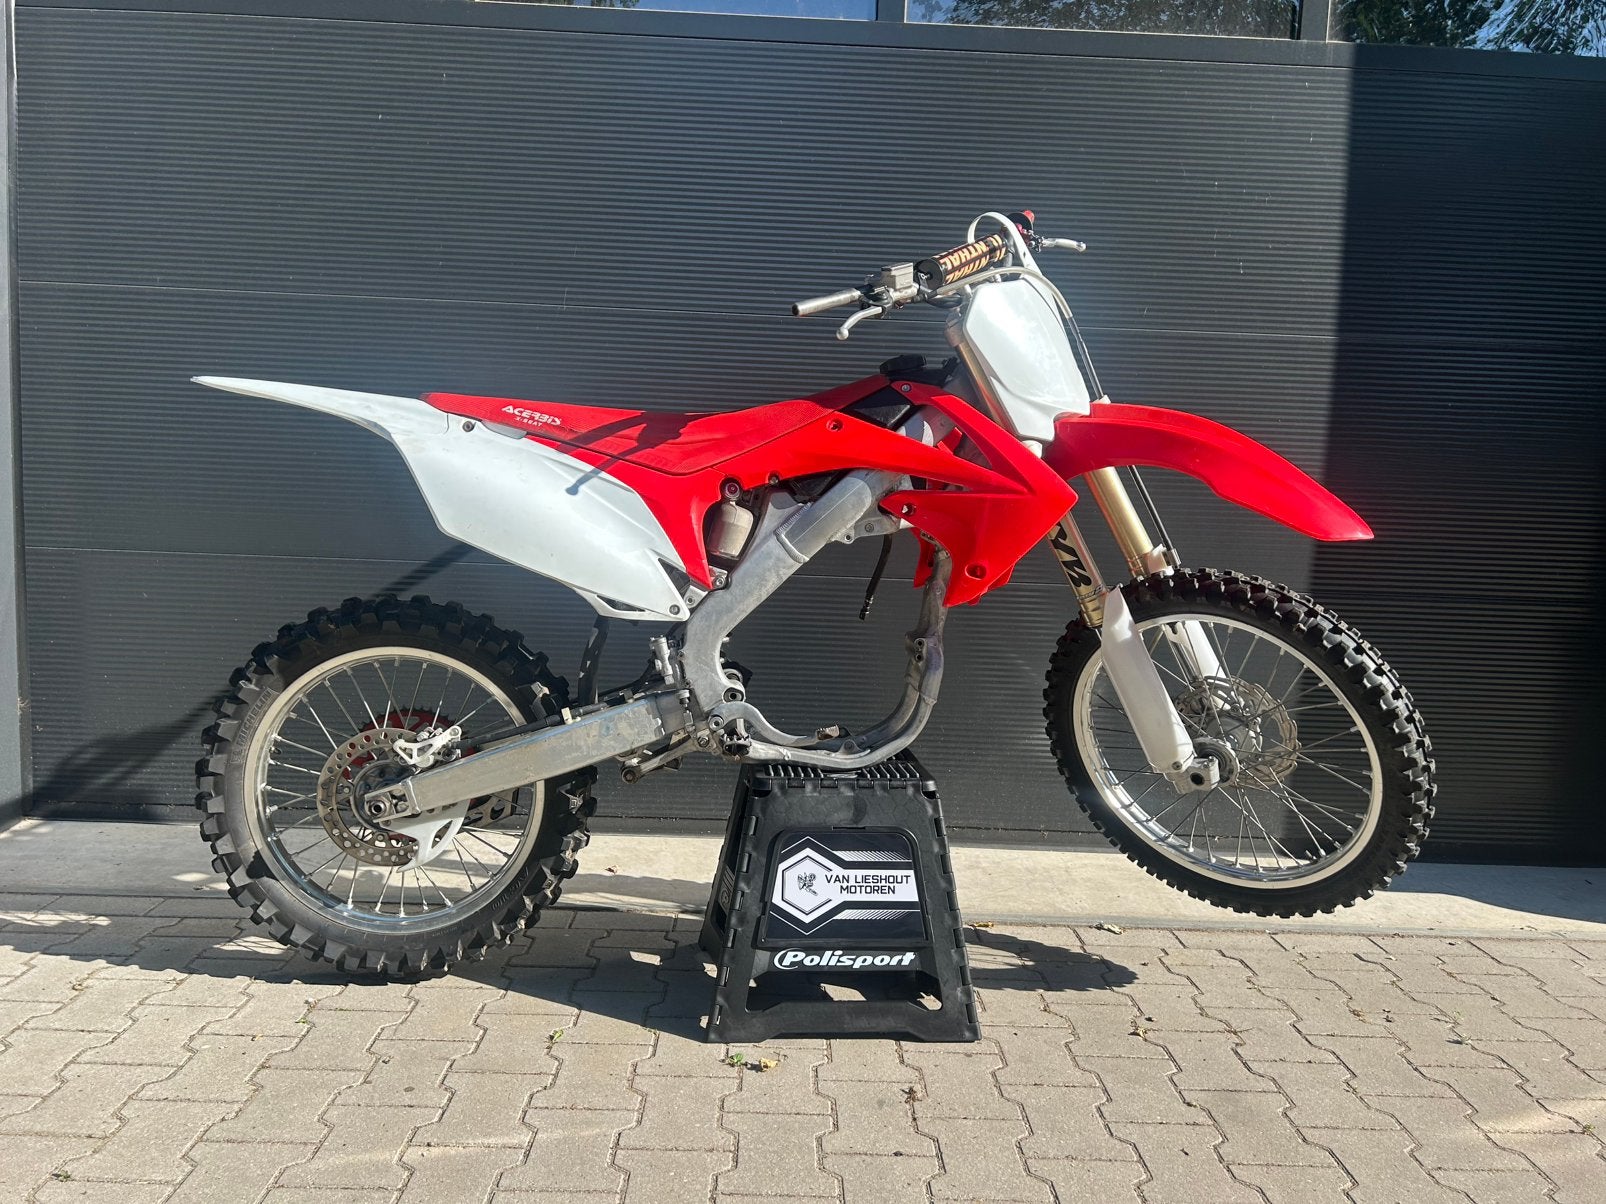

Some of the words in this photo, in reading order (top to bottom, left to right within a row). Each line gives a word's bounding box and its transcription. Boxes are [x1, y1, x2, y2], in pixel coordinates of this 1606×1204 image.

[939, 234, 1003, 271] NTHAL
[501, 405, 562, 426] ACERBIS
[1051, 521, 1092, 588] YB
[824, 874, 850, 884] VAN
[854, 874, 911, 884] LIESHOUT
[839, 885, 896, 895] MOTOREN
[778, 949, 916, 969] Polisport
